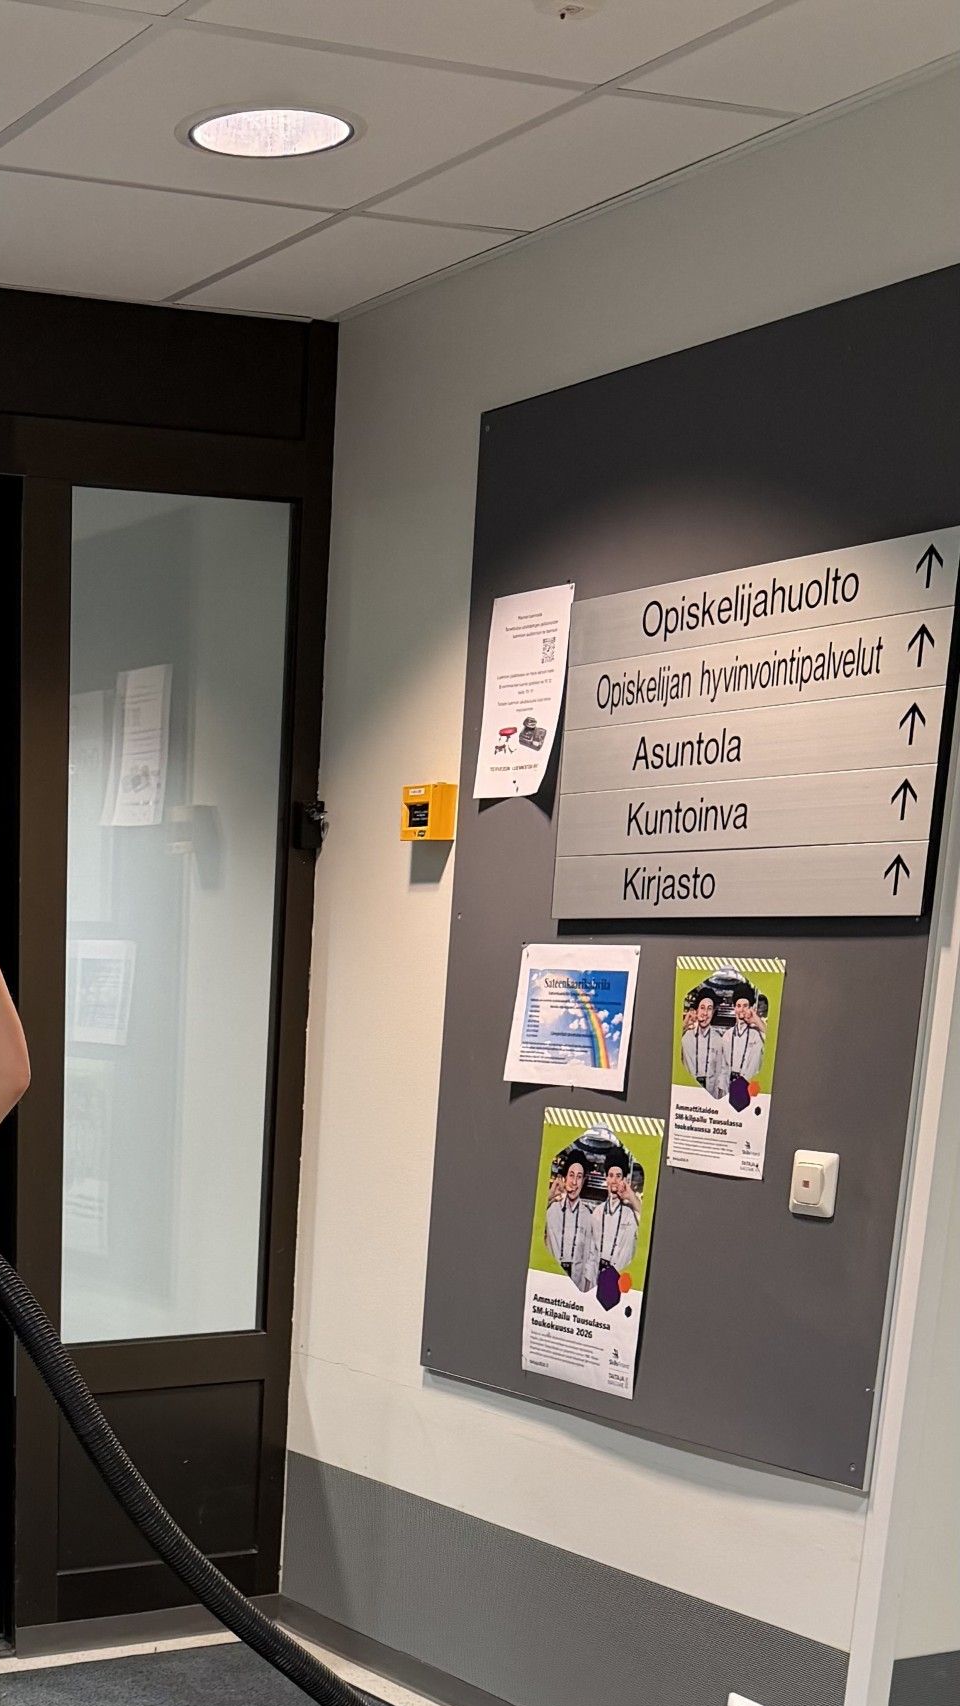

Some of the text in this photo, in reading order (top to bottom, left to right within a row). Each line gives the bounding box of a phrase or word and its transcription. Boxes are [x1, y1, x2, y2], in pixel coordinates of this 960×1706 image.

[642, 567, 860, 641] Opiskelijahuolto
[596, 636, 884, 714] Opiskelijan hyvinvointipalvelut
[632, 728, 742, 771] Asuntola
[626, 797, 749, 836] Kuntoinva
[622, 867, 716, 906] Kirjasto
[675, 1112, 743, 1128] SM-kilpailu Tuusulassa
[676, 1103, 719, 1115] Ammattitaidon
[532, 1305, 611, 1331] SM-kilpailu Tuusulassa
[533, 1293, 584, 1312] Ammattitaidon
[531, 1317, 593, 1339] toukokuussa 2026
